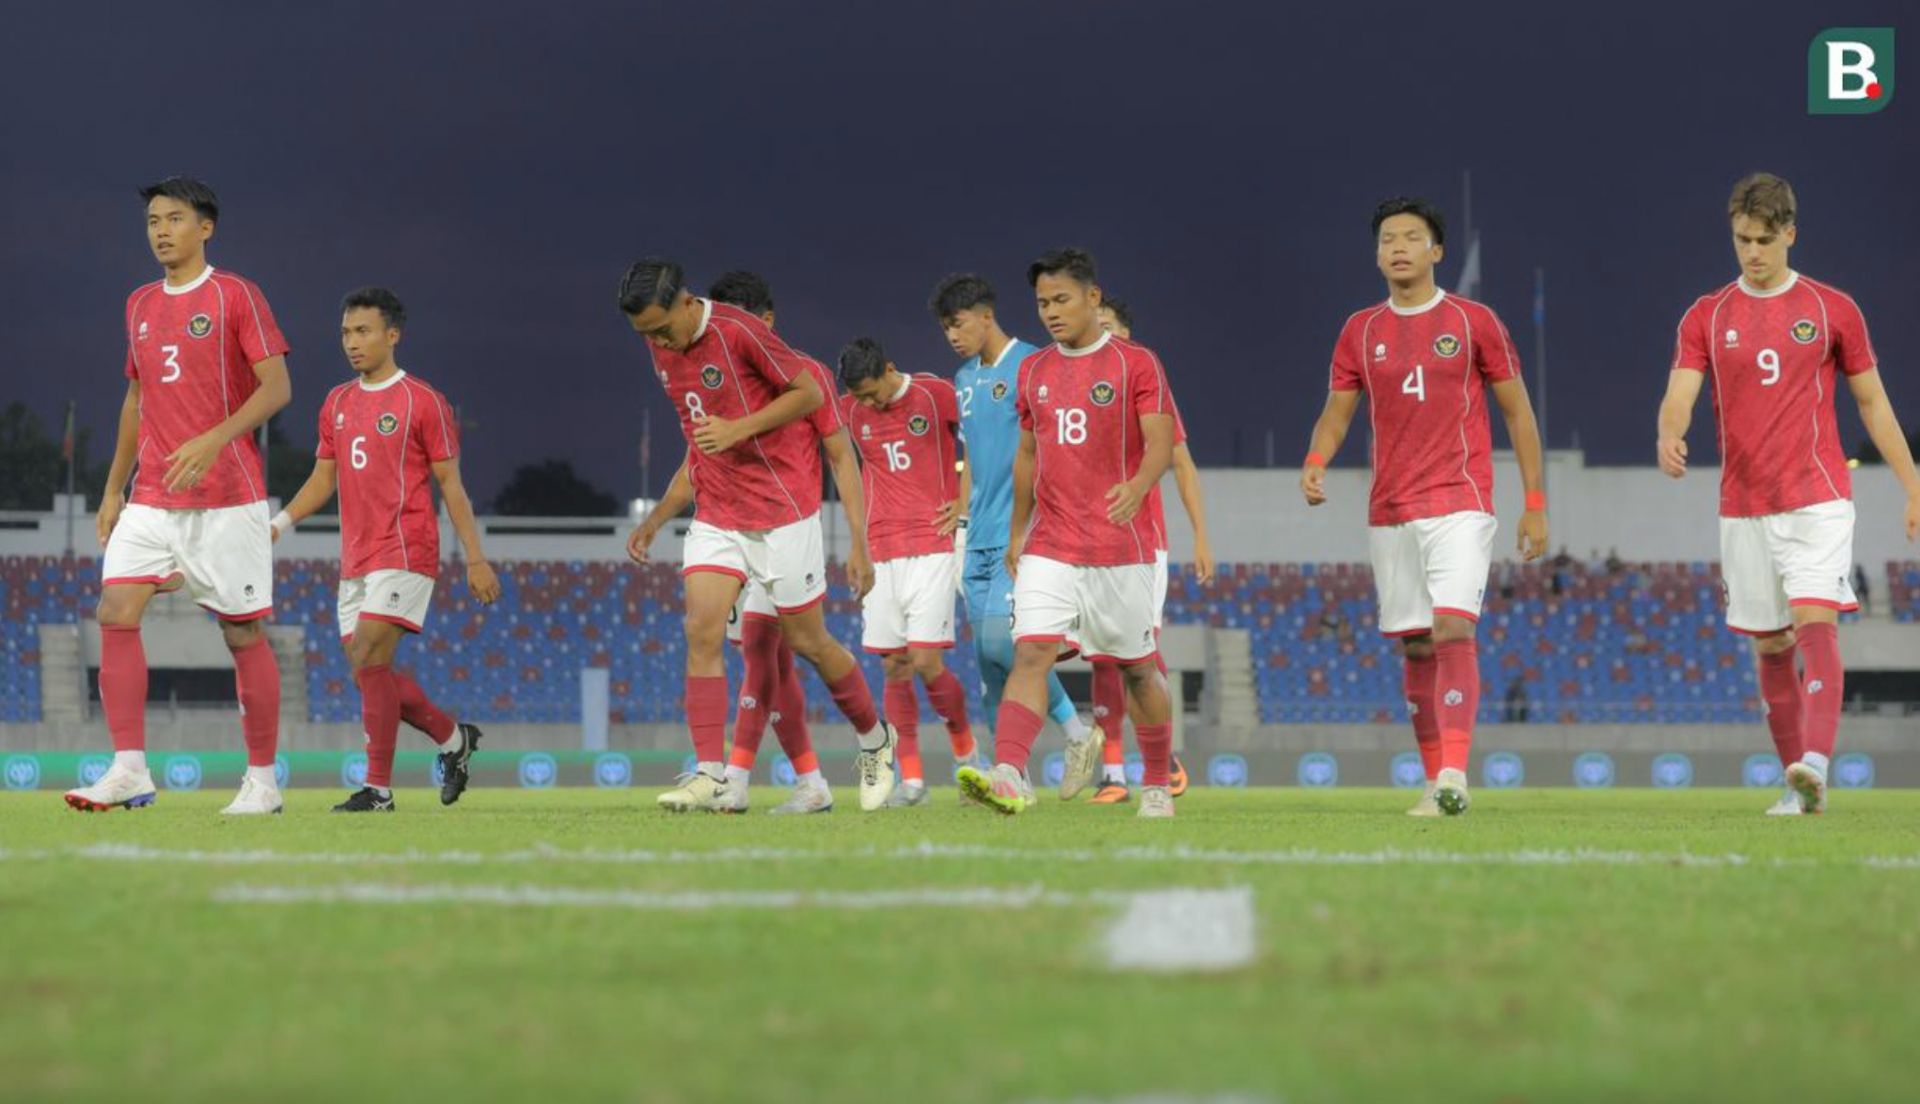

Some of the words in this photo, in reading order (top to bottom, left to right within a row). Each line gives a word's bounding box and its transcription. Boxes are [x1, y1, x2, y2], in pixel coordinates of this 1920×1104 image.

[160, 344, 182, 384] 3
[1401, 364, 1426, 402] 4
[1756, 348, 1780, 386] 9
[685, 391, 707, 423] 8
[1055, 407, 1088, 446] 18
[350, 435, 368, 470] 6
[882, 440, 912, 473] 16
